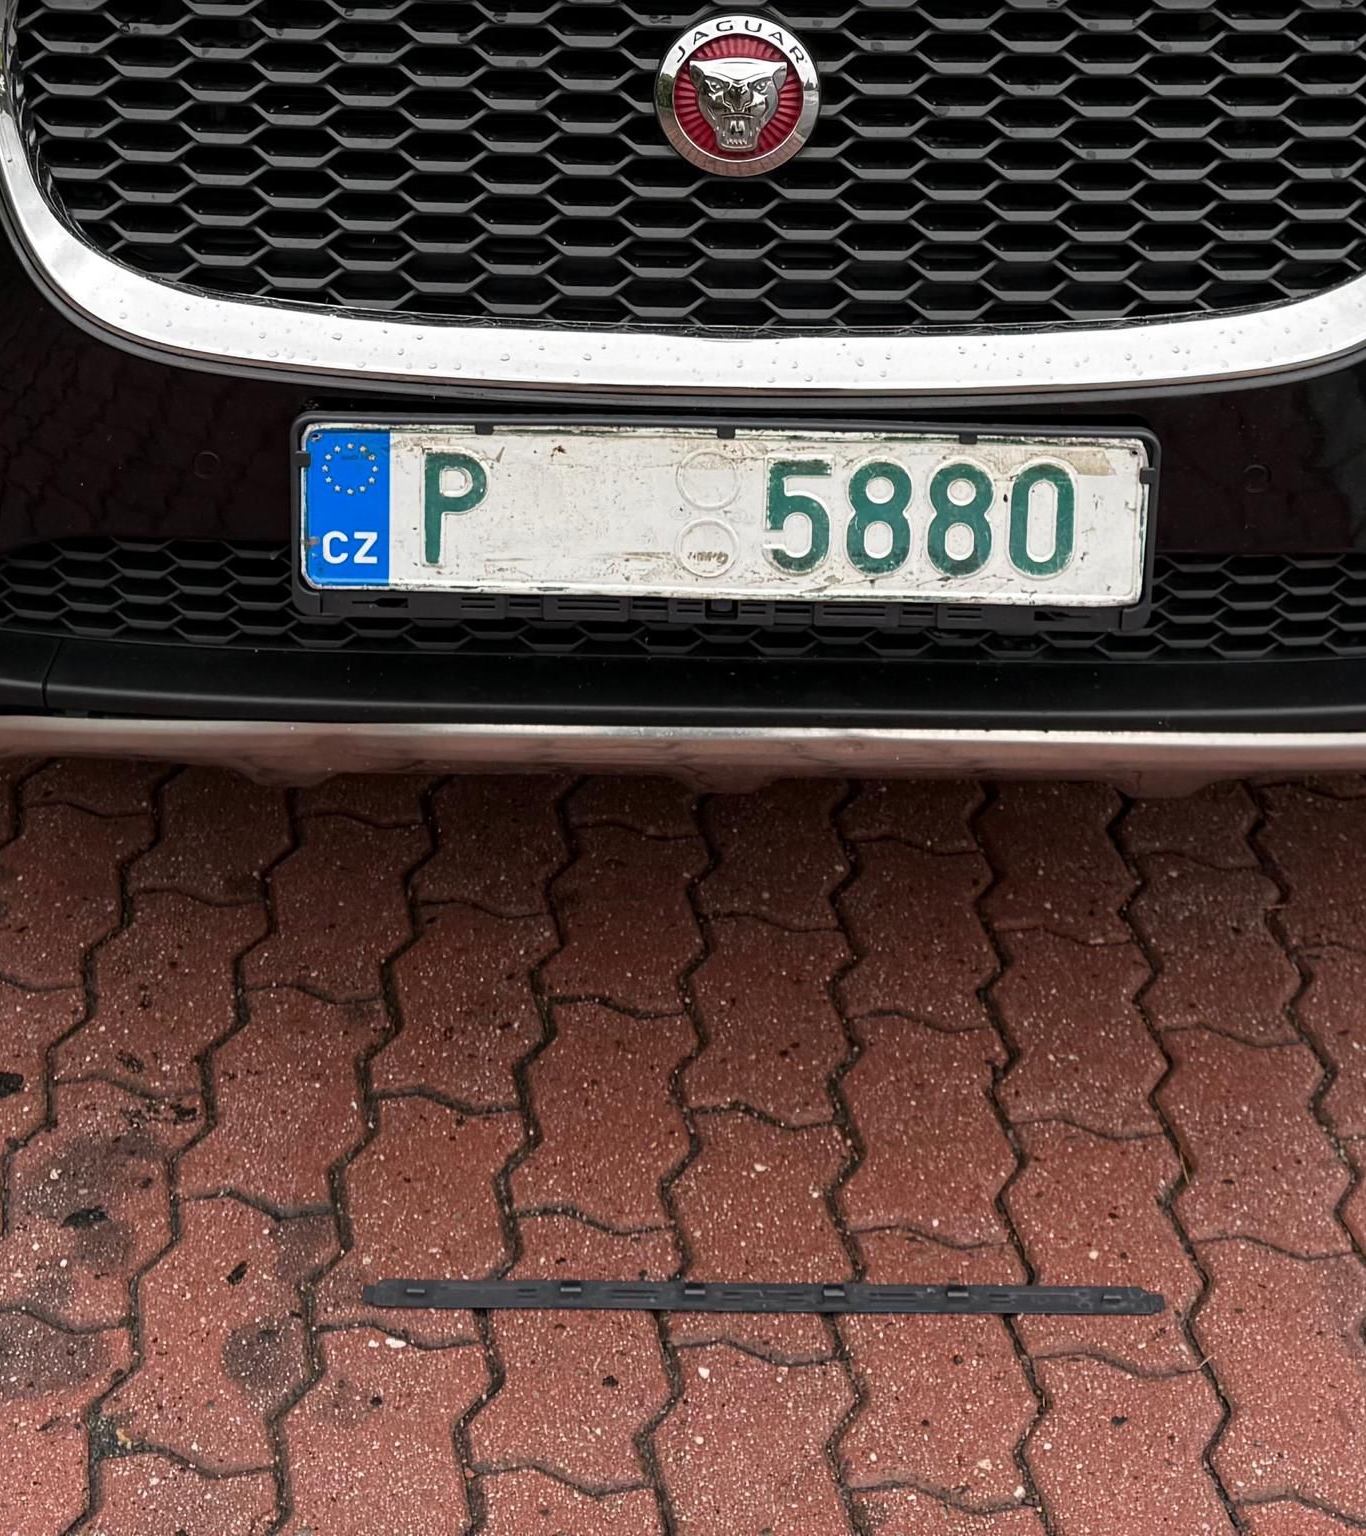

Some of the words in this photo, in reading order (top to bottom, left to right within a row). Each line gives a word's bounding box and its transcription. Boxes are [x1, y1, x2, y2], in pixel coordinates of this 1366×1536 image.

[676, 20, 805, 64] JAGUAR
[424, 451, 487, 564] P
[764, 458, 1076, 577] 5880
[322, 530, 378, 564] CZ
